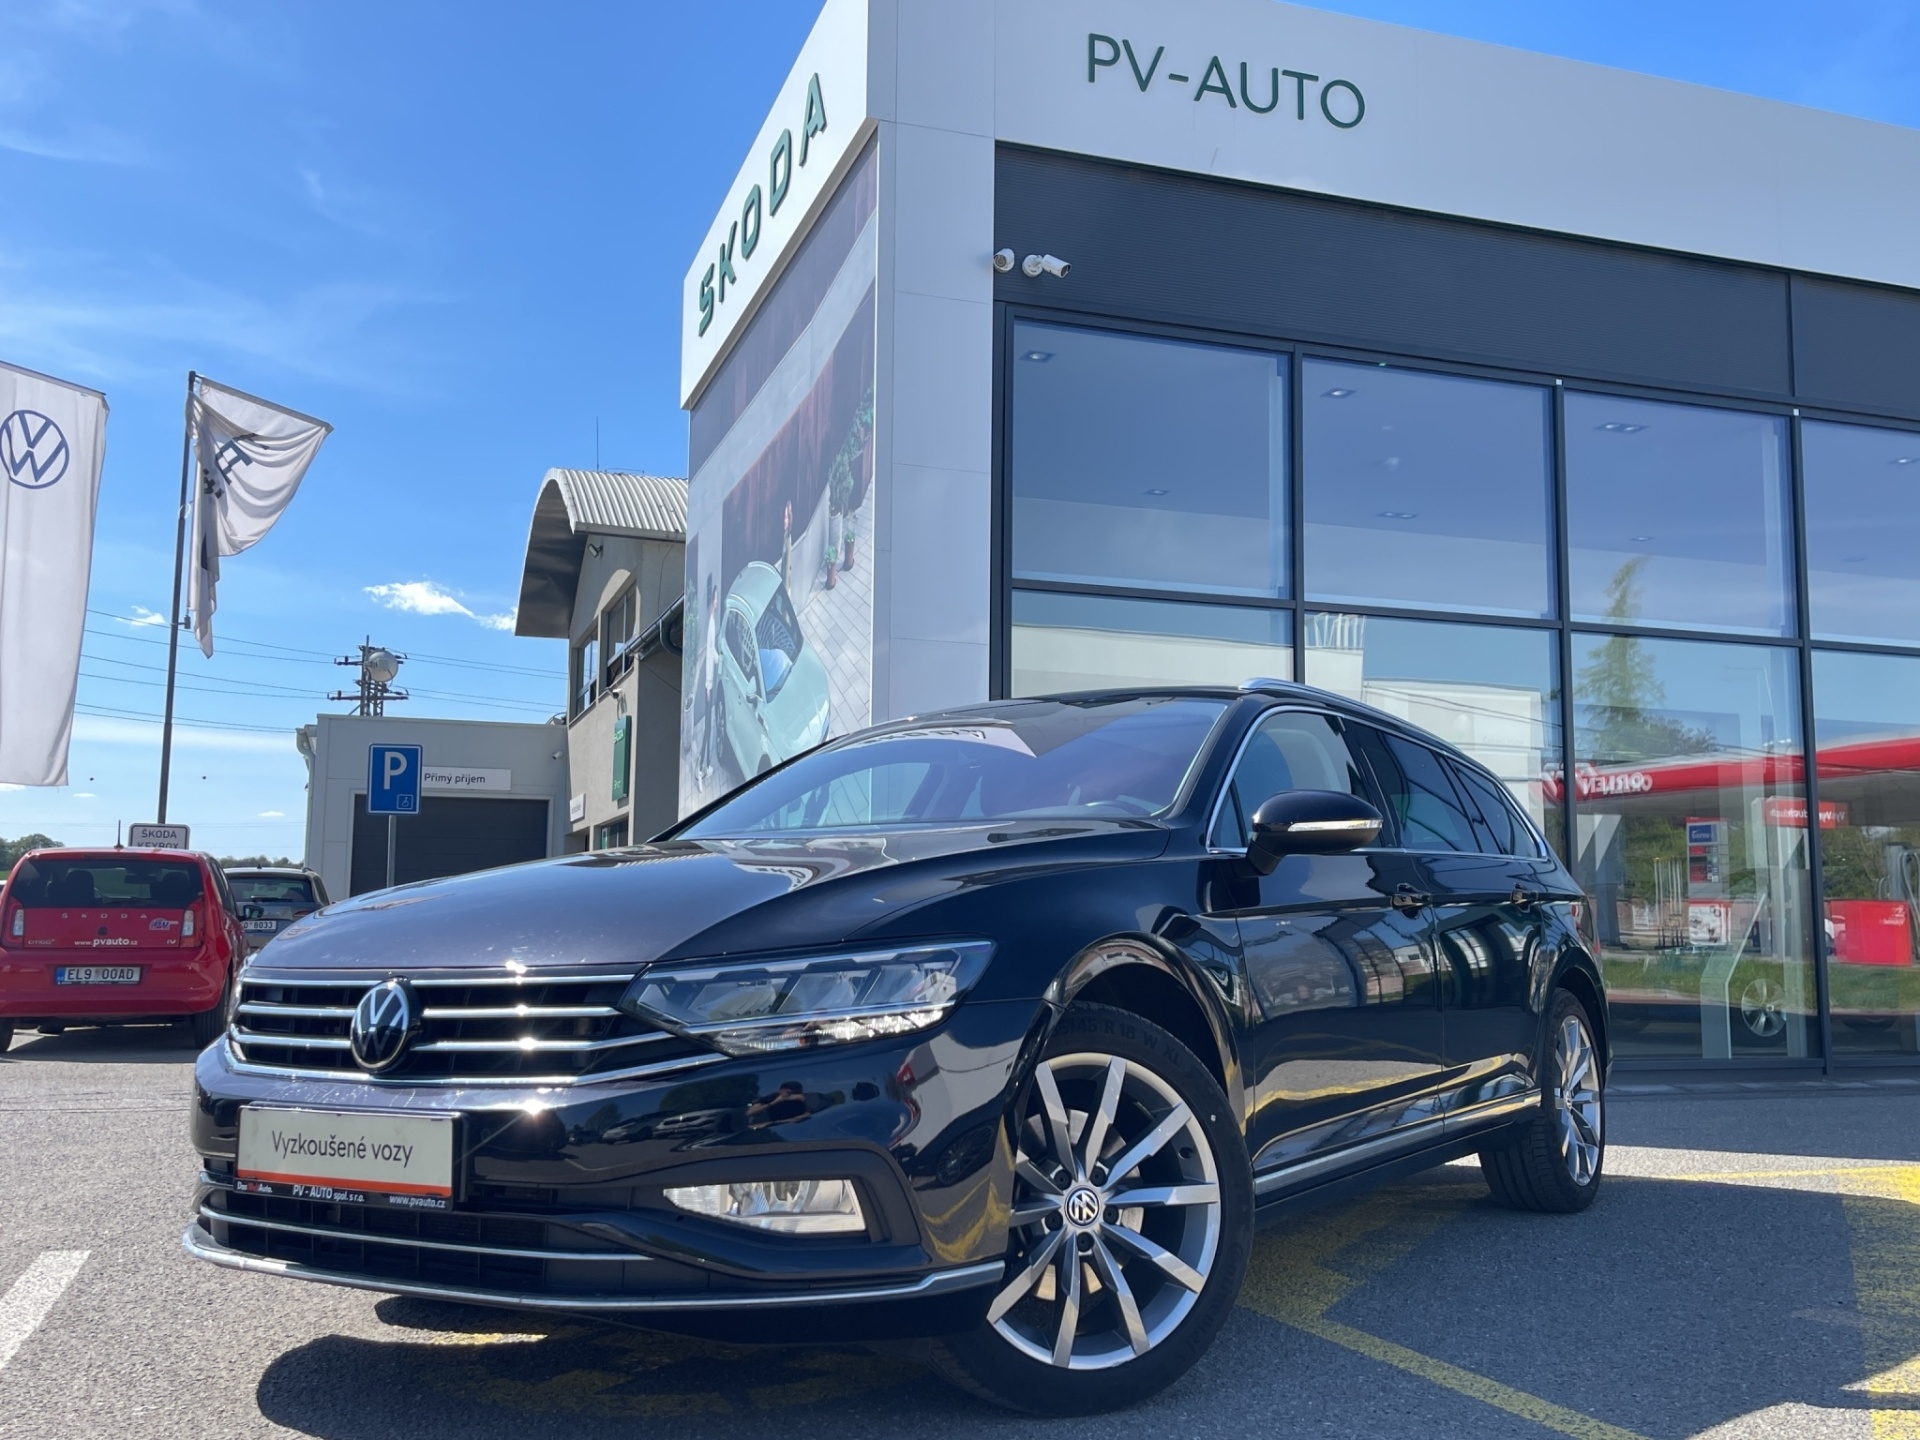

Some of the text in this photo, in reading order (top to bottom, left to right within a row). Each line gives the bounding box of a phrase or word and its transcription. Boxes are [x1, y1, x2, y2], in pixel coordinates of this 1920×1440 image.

[1088, 33, 1365, 129] PV-AUTO
[383, 751, 408, 790] P
[141, 828, 177, 839] ŠKODA
[74, 937, 138, 947] www.pvauto.cz
[67, 968, 92, 980] EL9
[272, 1130, 413, 1168] Vyzkoušené vozy
[309, 1187, 333, 1199] AUTO
[389, 1195, 446, 1208] www.pvauto.cz
